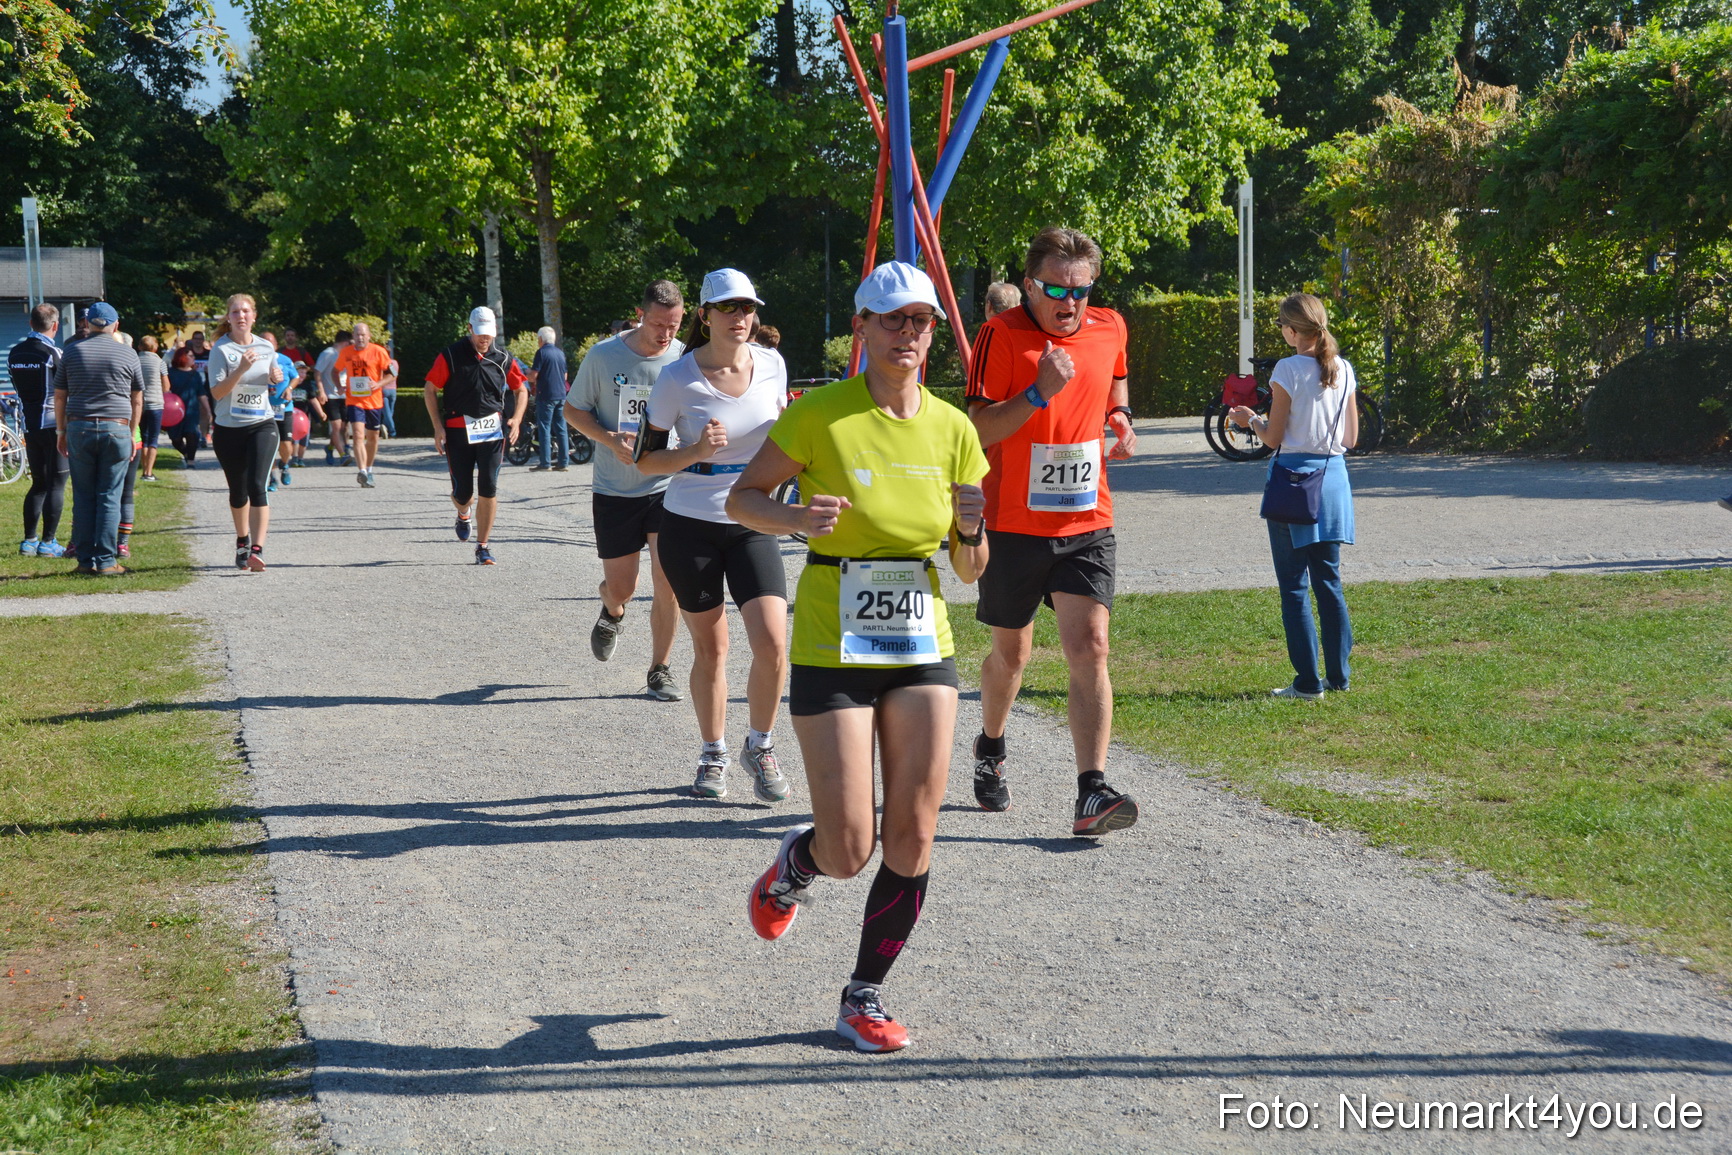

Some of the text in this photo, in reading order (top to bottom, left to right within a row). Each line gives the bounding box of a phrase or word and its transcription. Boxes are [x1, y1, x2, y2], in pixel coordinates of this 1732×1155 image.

[237, 393, 262, 405] 2033
[471, 418, 496, 430] 2122
[1053, 449, 1085, 459] BOCK
[1041, 461, 1092, 484] 2112
[1058, 495, 1075, 505] Jan
[871, 570, 915, 582] BOCK
[856, 589, 924, 621] 2540
[862, 624, 916, 632] PARTL Neumarkt
[871, 638, 917, 652] Pamela
